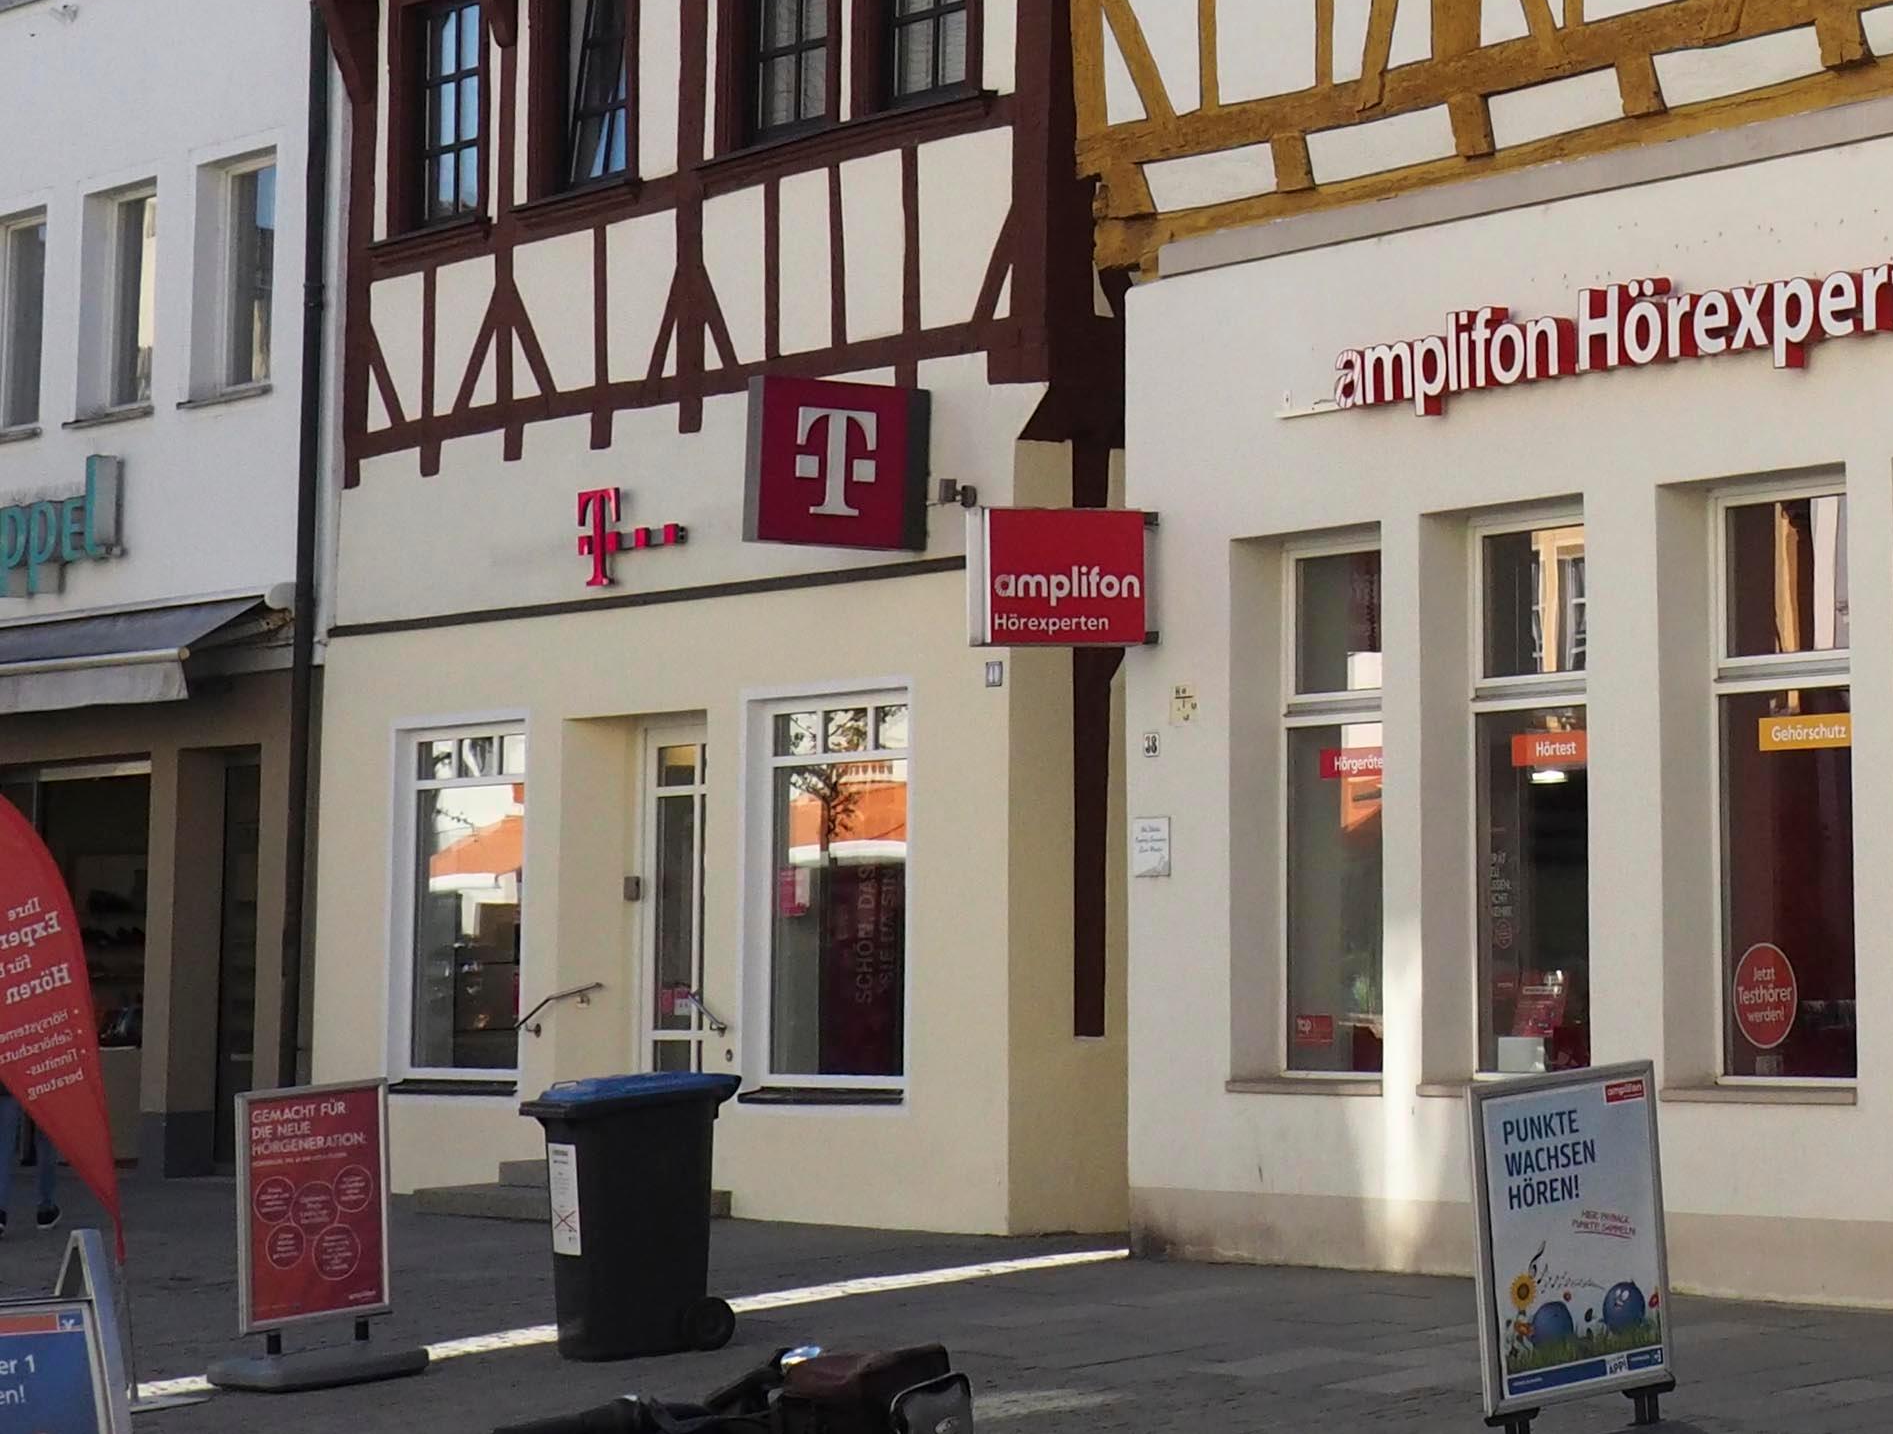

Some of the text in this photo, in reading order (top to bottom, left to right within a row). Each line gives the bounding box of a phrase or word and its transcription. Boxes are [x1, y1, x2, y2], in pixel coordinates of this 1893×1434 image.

[1334, 306, 1562, 417] amplifon
[994, 566, 1140, 607] amplifon
[994, 613, 1109, 635] Hörexperten
[1771, 724, 1847, 744] Gehörschutz
[1535, 740, 1577, 757] Hörtest
[1753, 966, 1775, 981] Jetzt
[1737, 983, 1793, 1005] Testhörer
[252, 1099, 346, 1123] GEMACHT FÜR
[252, 1121, 311, 1140] DIE NEUE
[1502, 1109, 1580, 1146] PUNKTE
[1505, 1138, 1596, 1178] WACHSEN
[1508, 1174, 1581, 1210] HÖREN!
[25, 1354, 36, 1373] 1
